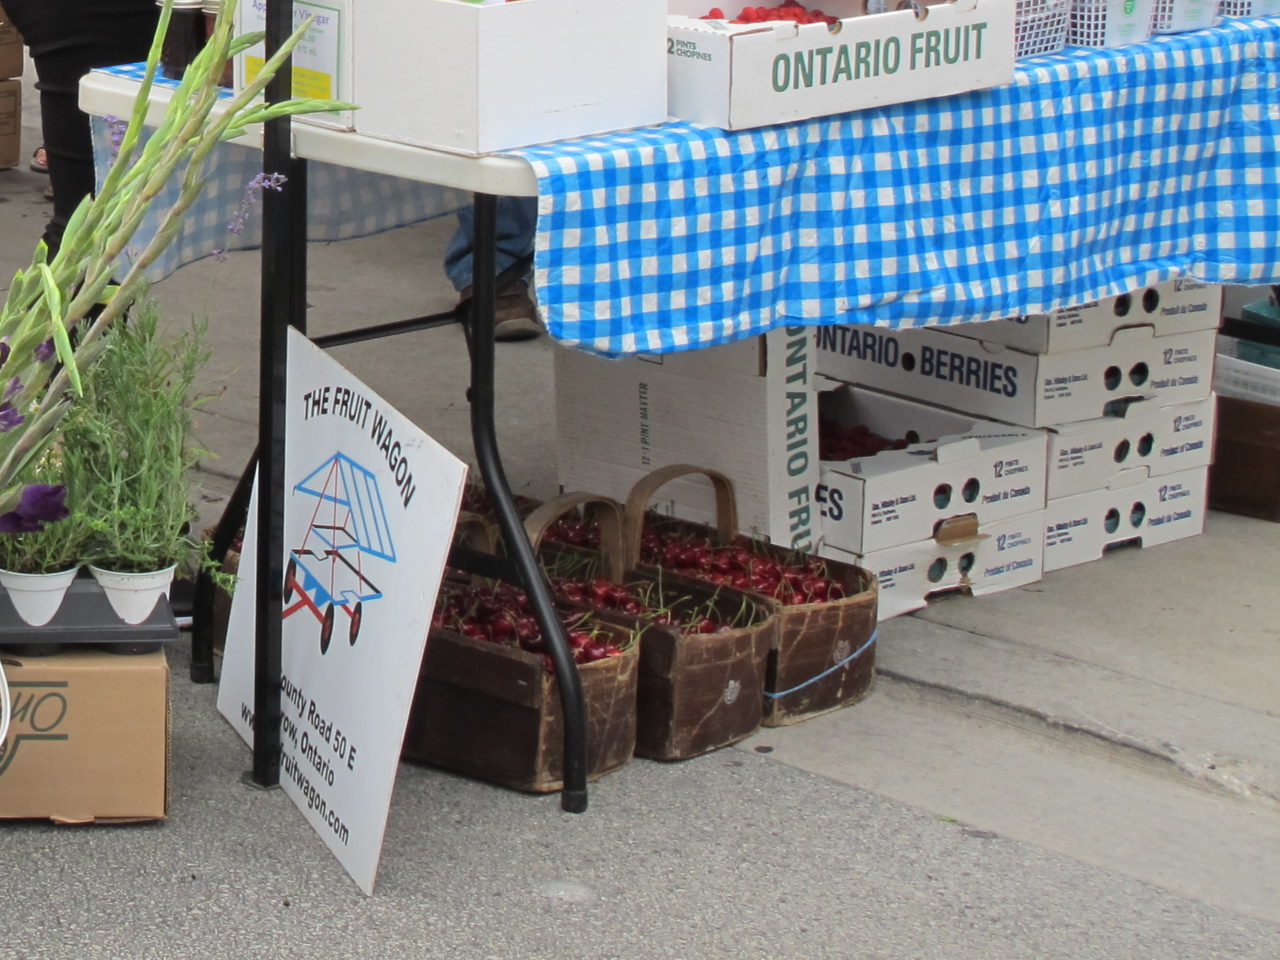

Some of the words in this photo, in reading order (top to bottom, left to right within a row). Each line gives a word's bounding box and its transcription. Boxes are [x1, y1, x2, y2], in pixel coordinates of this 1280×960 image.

[252, 0, 266, 12] App
[300, 10, 330, 25] Vingar
[675, 40, 697, 50] PINTS
[675, 47, 712, 62] CHOPINES
[771, 36, 901, 93] ONTARIO
[909, 22, 988, 70] FRUIT
[1163, 349, 1173, 365] 12
[920, 346, 1018, 399] BERRIES
[638, 382, 649, 420] MASTER
[784, 324, 810, 478] ONTARIO
[640, 423, 650, 446] PINT
[1173, 416, 1182, 432] 12
[304, 387, 331, 421] THE
[332, 387, 372, 429] FRUIT
[371, 409, 416, 509] WAGON
[993, 460, 1003, 478] 12
[1158, 485, 1167, 503] 12
[788, 489, 811, 554] FRU
[996, 534, 1006, 552] 12
[280, 675, 307, 717] ounty
[308, 699, 333, 742] Road
[333, 730, 347, 759] 50
[348, 746, 357, 771] E
[300, 731, 335, 787] Ontario
